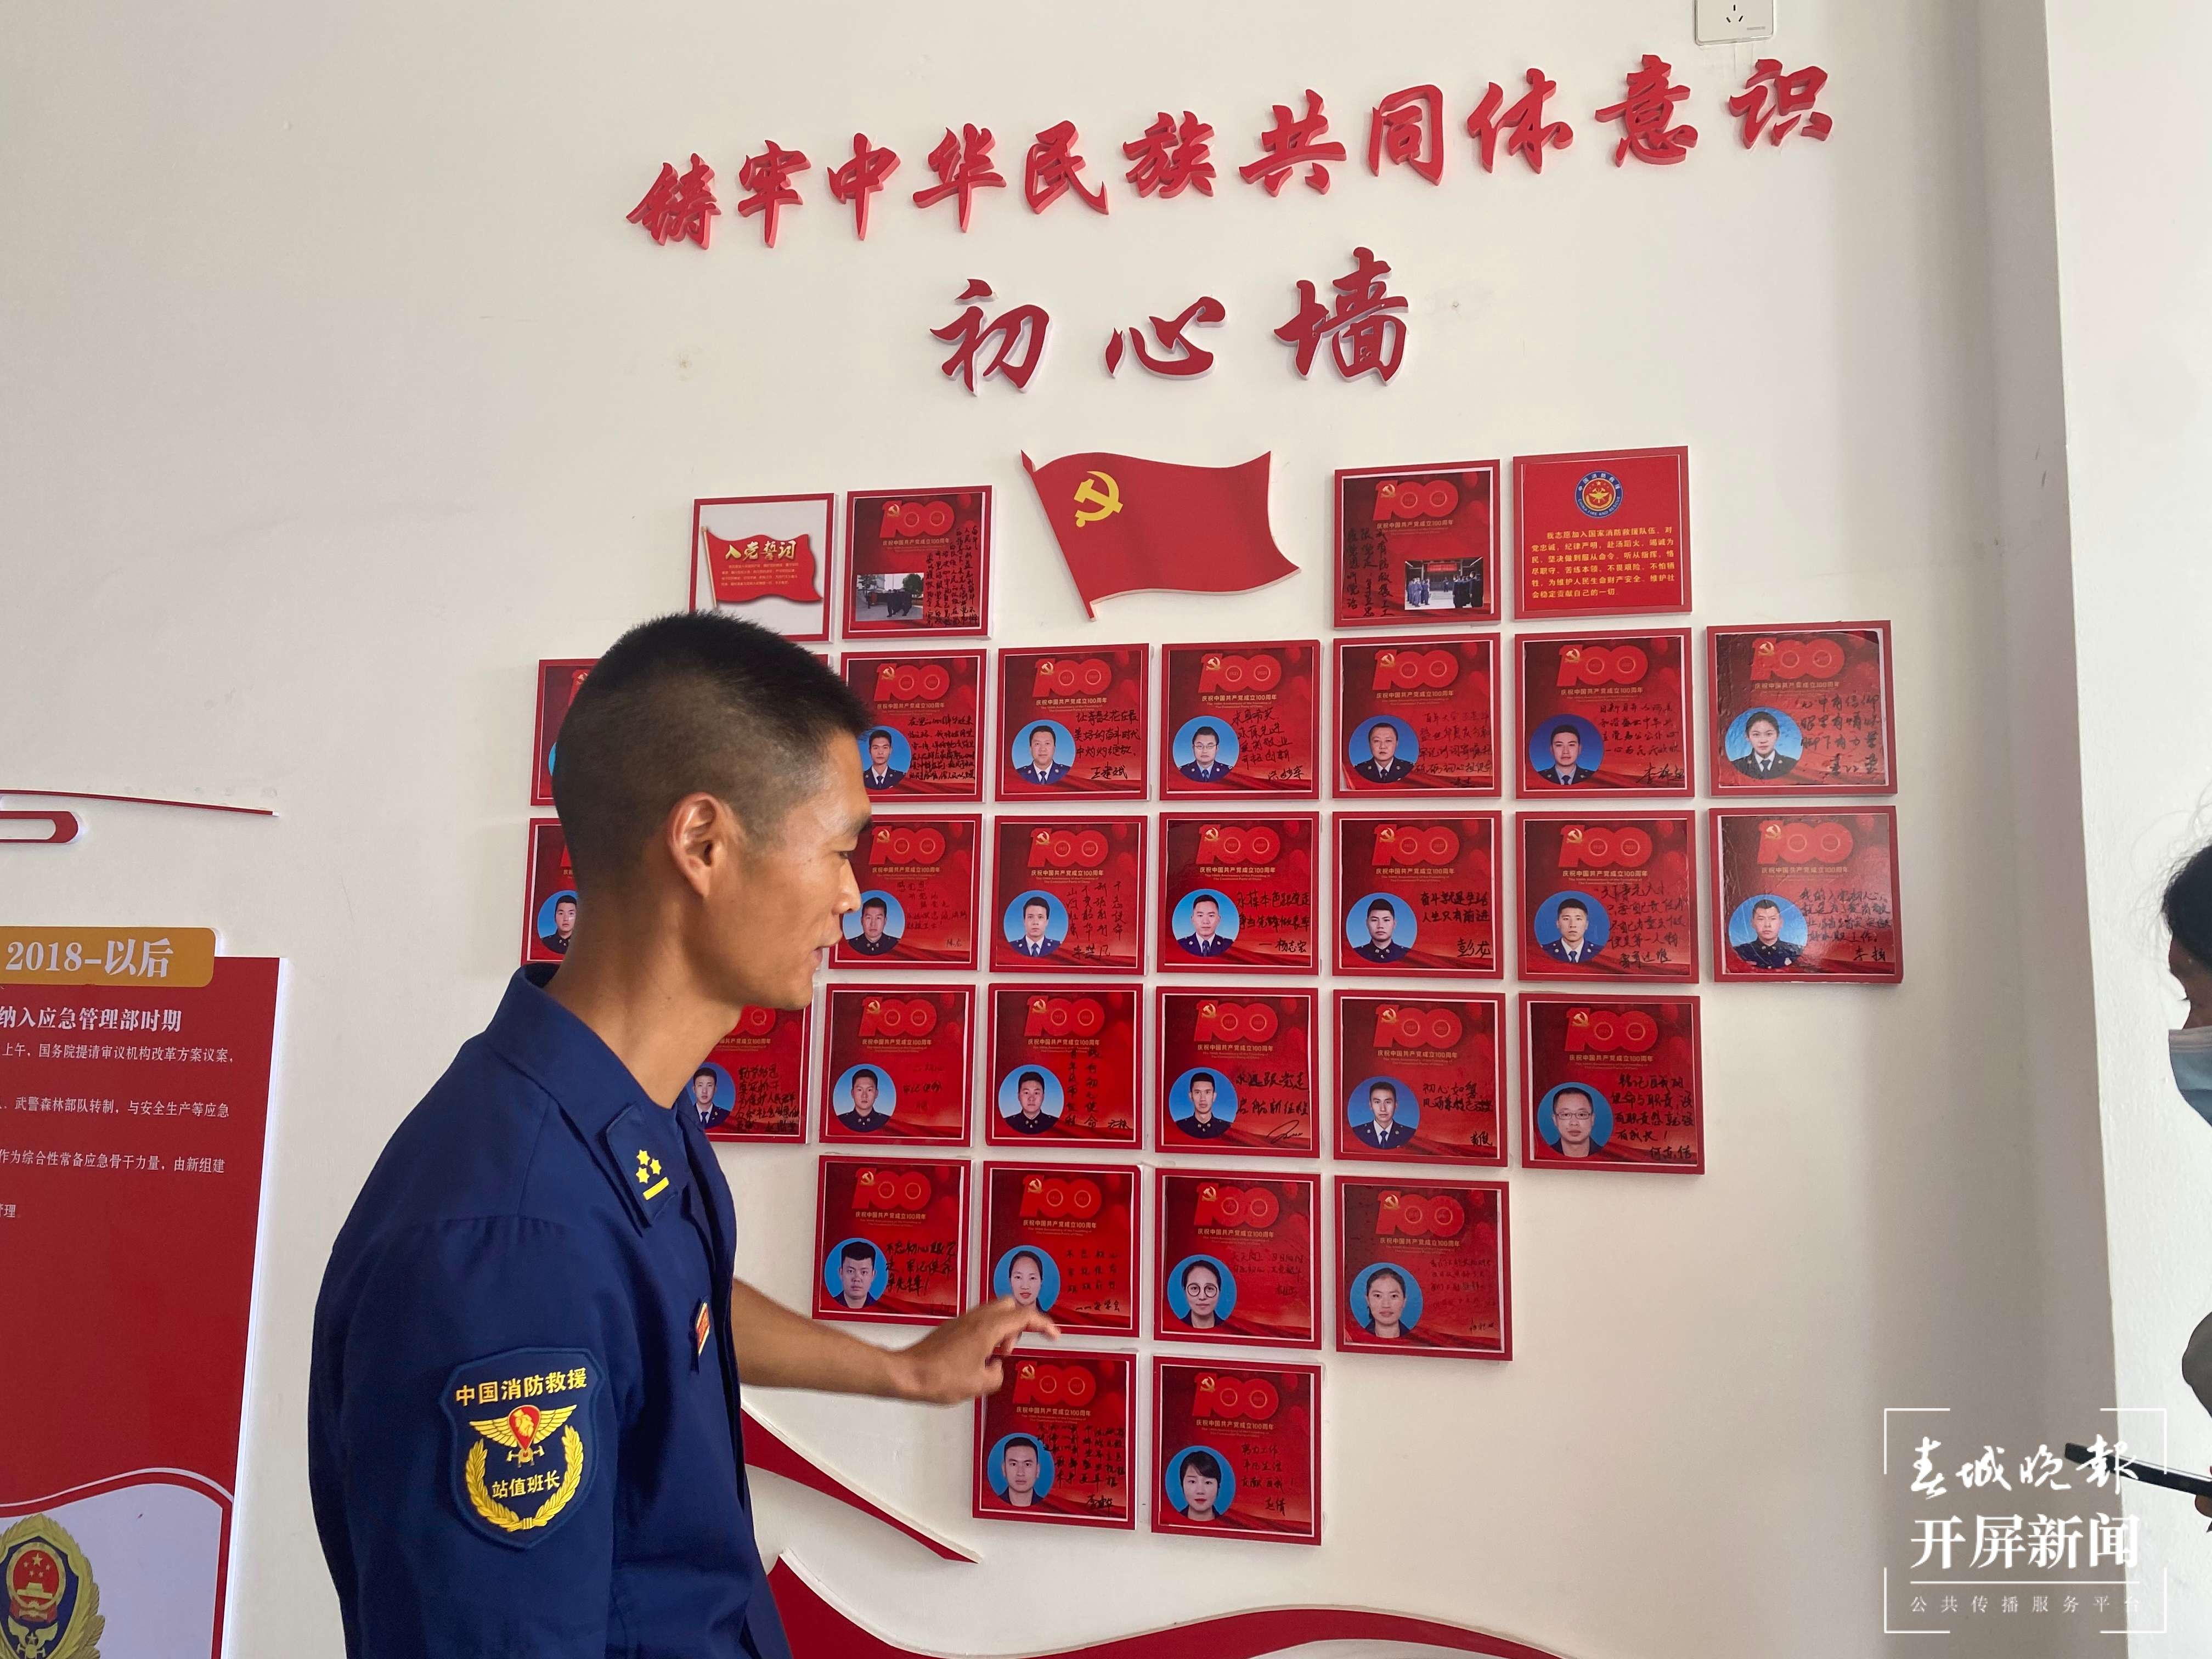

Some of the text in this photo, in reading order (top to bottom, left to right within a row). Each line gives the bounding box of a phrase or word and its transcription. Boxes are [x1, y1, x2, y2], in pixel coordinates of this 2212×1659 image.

[625, 54, 1836, 250] 铸牢中华民族共同体意识
[929, 246, 1412, 397] 初心墙
[725, 540, 797, 561] 入党誓词
[5, 938, 173, 978] 2018-以后
[0, 1006, 183, 1032] 纳入应急管理部时期
[0, 1096, 229, 1119] 、武警森林部队转制，与安全生产等应急
[455, 1367, 588, 1407] 中国消防救援
[492, 1469, 561, 1499] 站值班长
